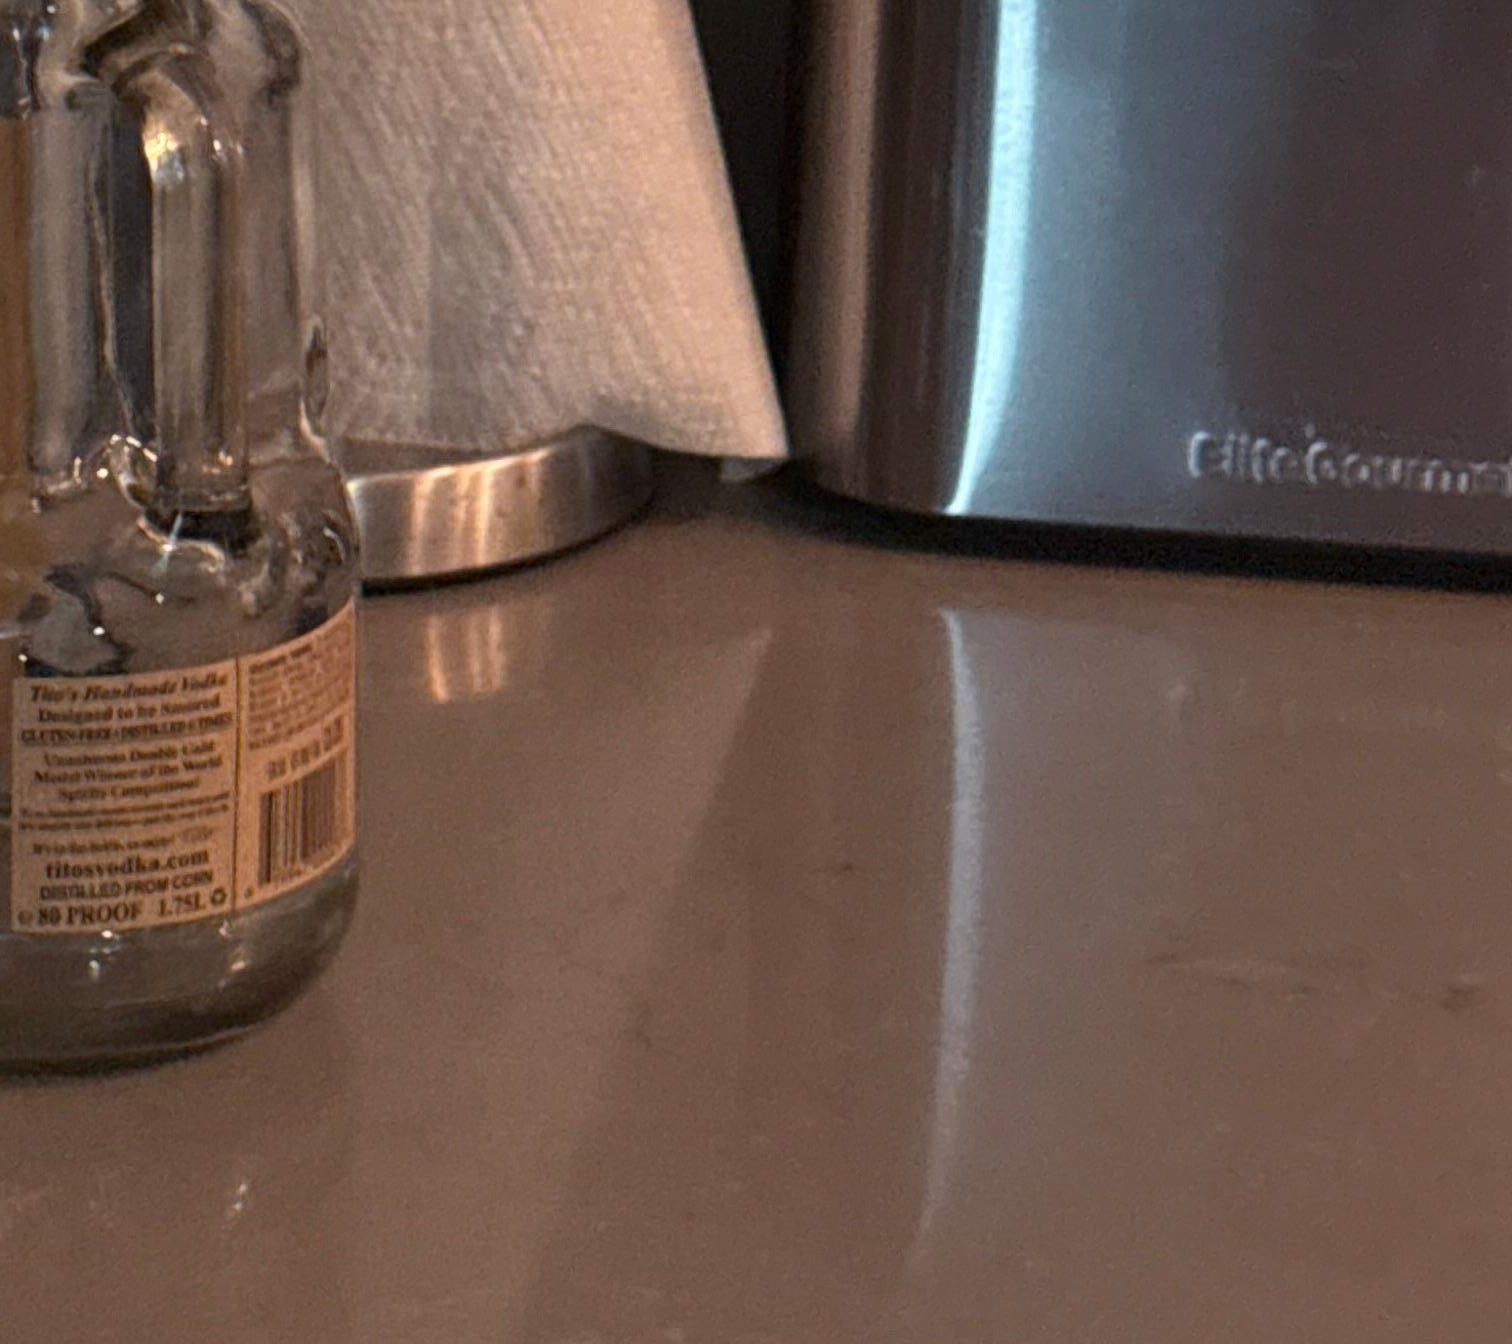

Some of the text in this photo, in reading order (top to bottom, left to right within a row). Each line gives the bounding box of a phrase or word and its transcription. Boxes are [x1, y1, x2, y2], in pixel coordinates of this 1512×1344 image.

[83, 678, 178, 701] Handmade
[182, 671, 228, 691] Vodka
[39, 706, 114, 725] Designed
[118, 706, 134, 719] to
[45, 849, 209, 879] titosvodka.com
[40, 869, 214, 901] DISTILLED FROM CORN
[38, 907, 61, 925] 80
[66, 902, 142, 926] PROOF
